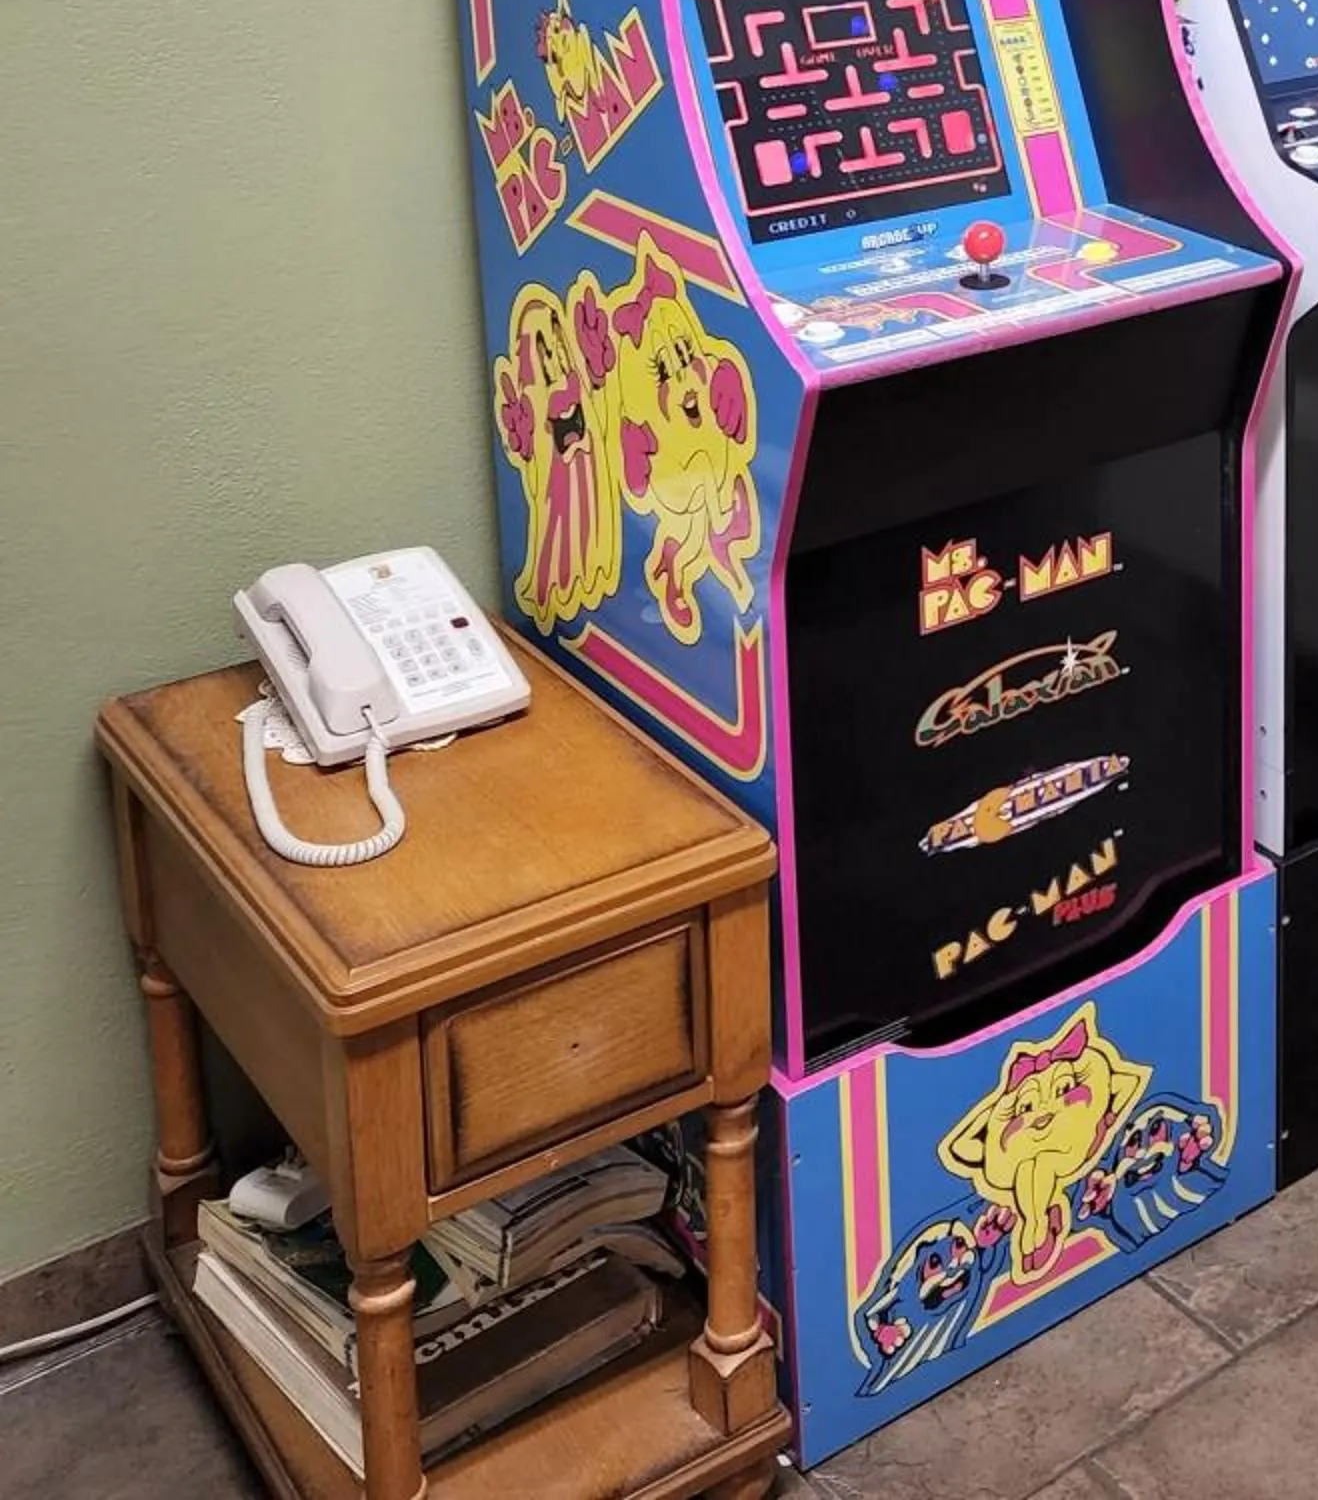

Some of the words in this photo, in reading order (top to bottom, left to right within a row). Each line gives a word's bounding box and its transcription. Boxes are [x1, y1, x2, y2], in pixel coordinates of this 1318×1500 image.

[768, 212, 828, 234] CREDIT
[918, 531, 1113, 637] PAC-MAN
[920, 537, 988, 587] MS.
[931, 837, 1118, 980] PAC-MAN
